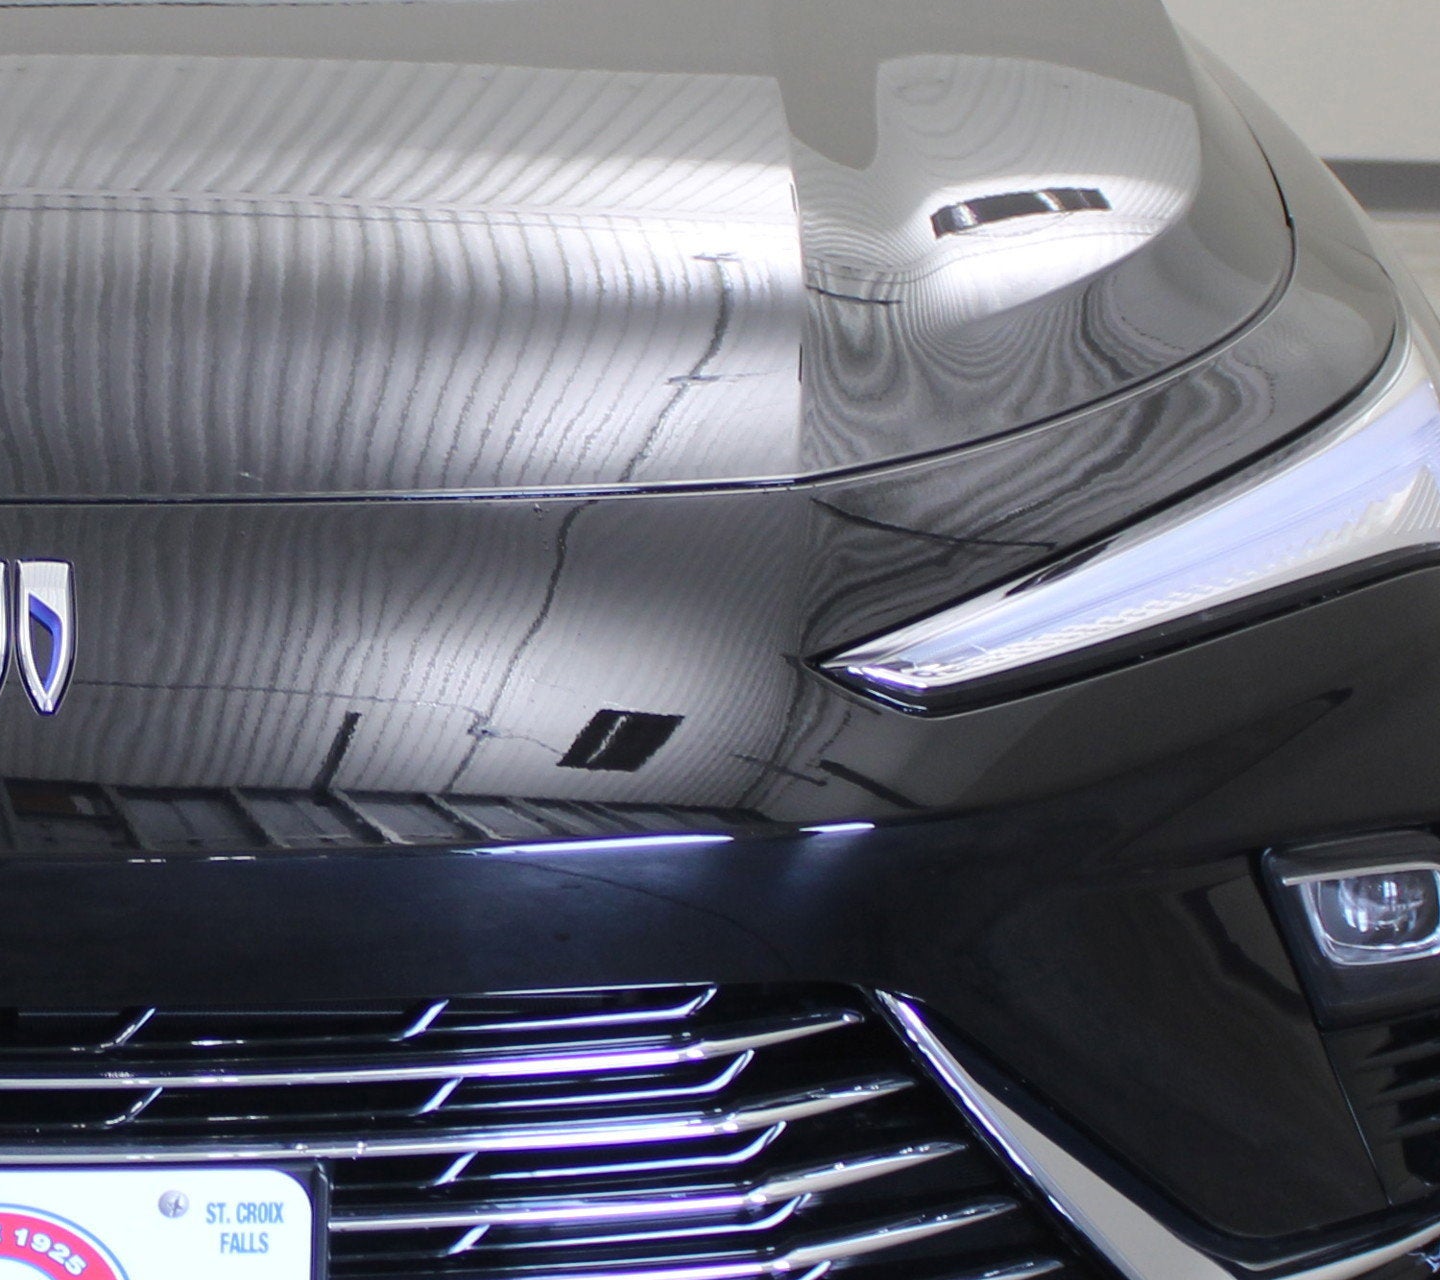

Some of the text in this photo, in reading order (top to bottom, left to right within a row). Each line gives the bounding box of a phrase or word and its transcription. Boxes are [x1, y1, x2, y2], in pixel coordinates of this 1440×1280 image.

[205, 1201, 285, 1225] ST. CROIX
[13, 1227, 88, 1276] 1925
[219, 1231, 270, 1254] FALLS
